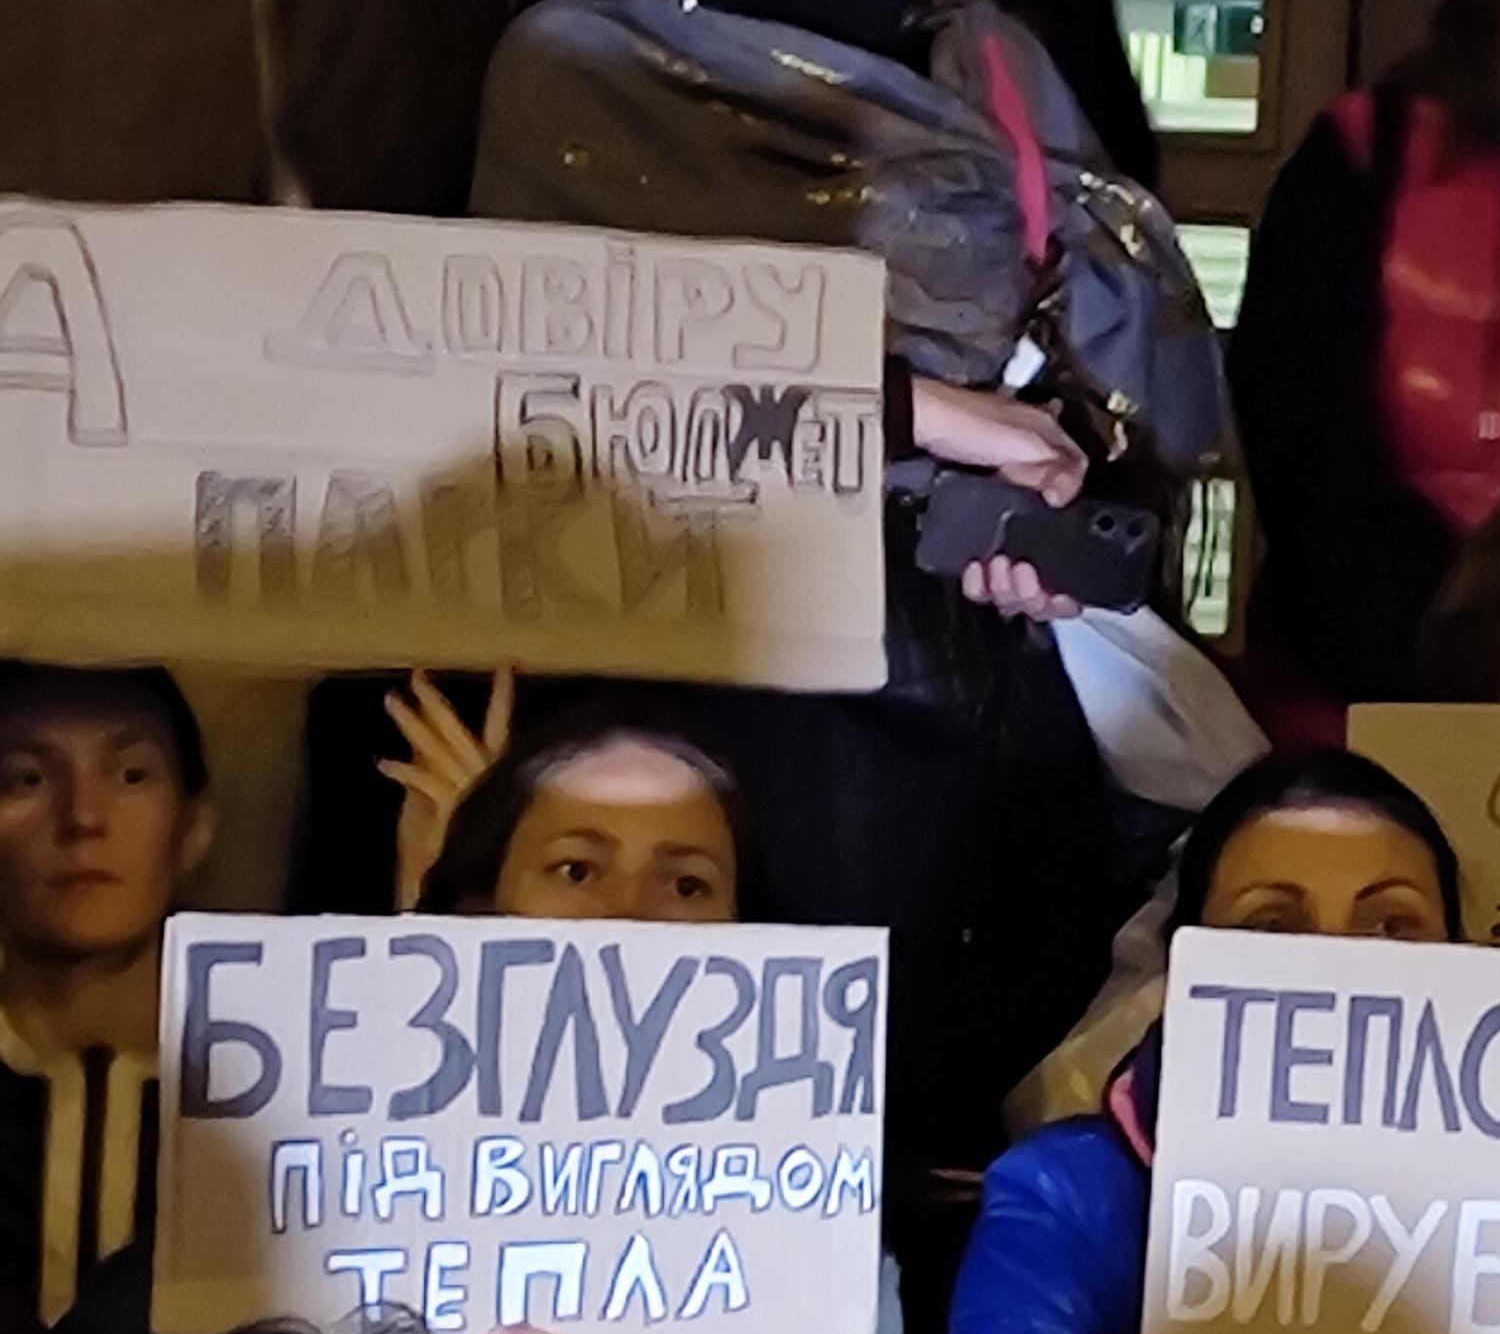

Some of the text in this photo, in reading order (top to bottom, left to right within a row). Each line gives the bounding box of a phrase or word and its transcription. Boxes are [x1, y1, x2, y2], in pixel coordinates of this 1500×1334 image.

[179, 933, 881, 1125] БЕЗГЛУЗДЯ
[468, 1134, 877, 1219] ВИГЛЯДОМ
[325, 1227, 752, 1332] ТЕПЛА
